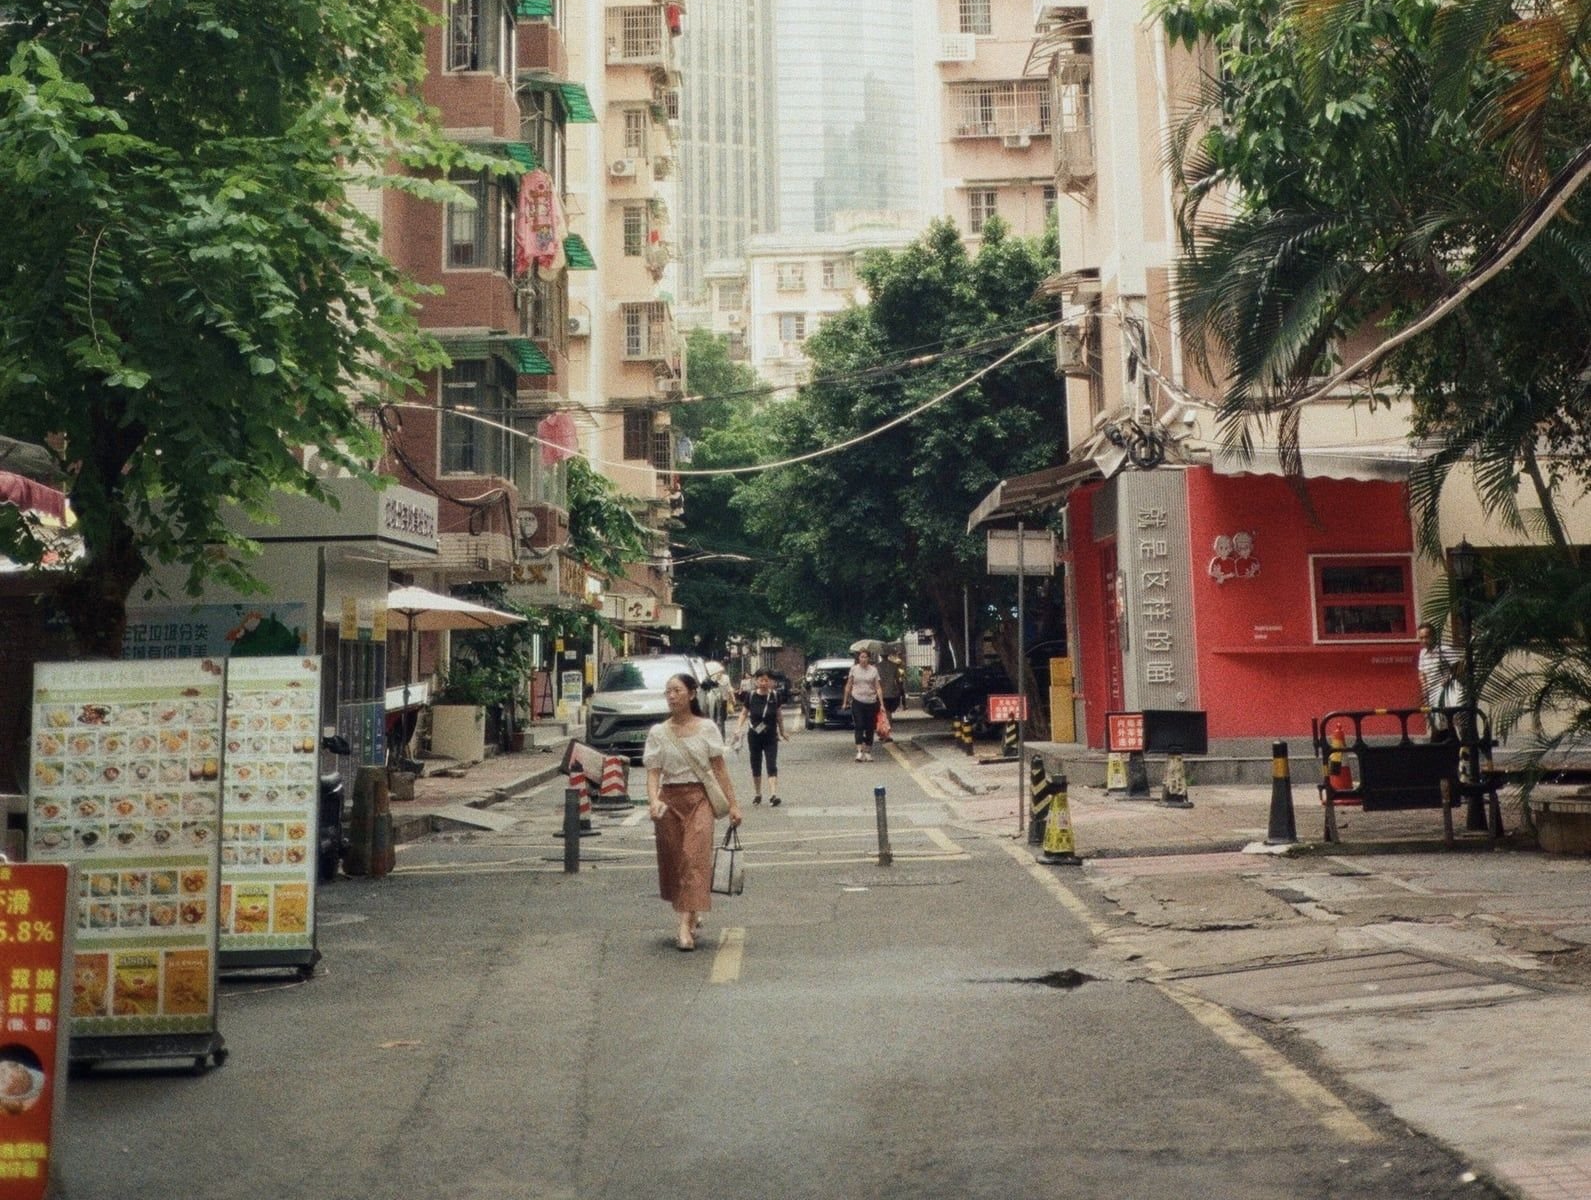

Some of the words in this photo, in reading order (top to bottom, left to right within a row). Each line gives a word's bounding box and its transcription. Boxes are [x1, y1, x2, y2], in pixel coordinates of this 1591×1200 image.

[1137, 506, 1177, 685] 就是这样的喵
